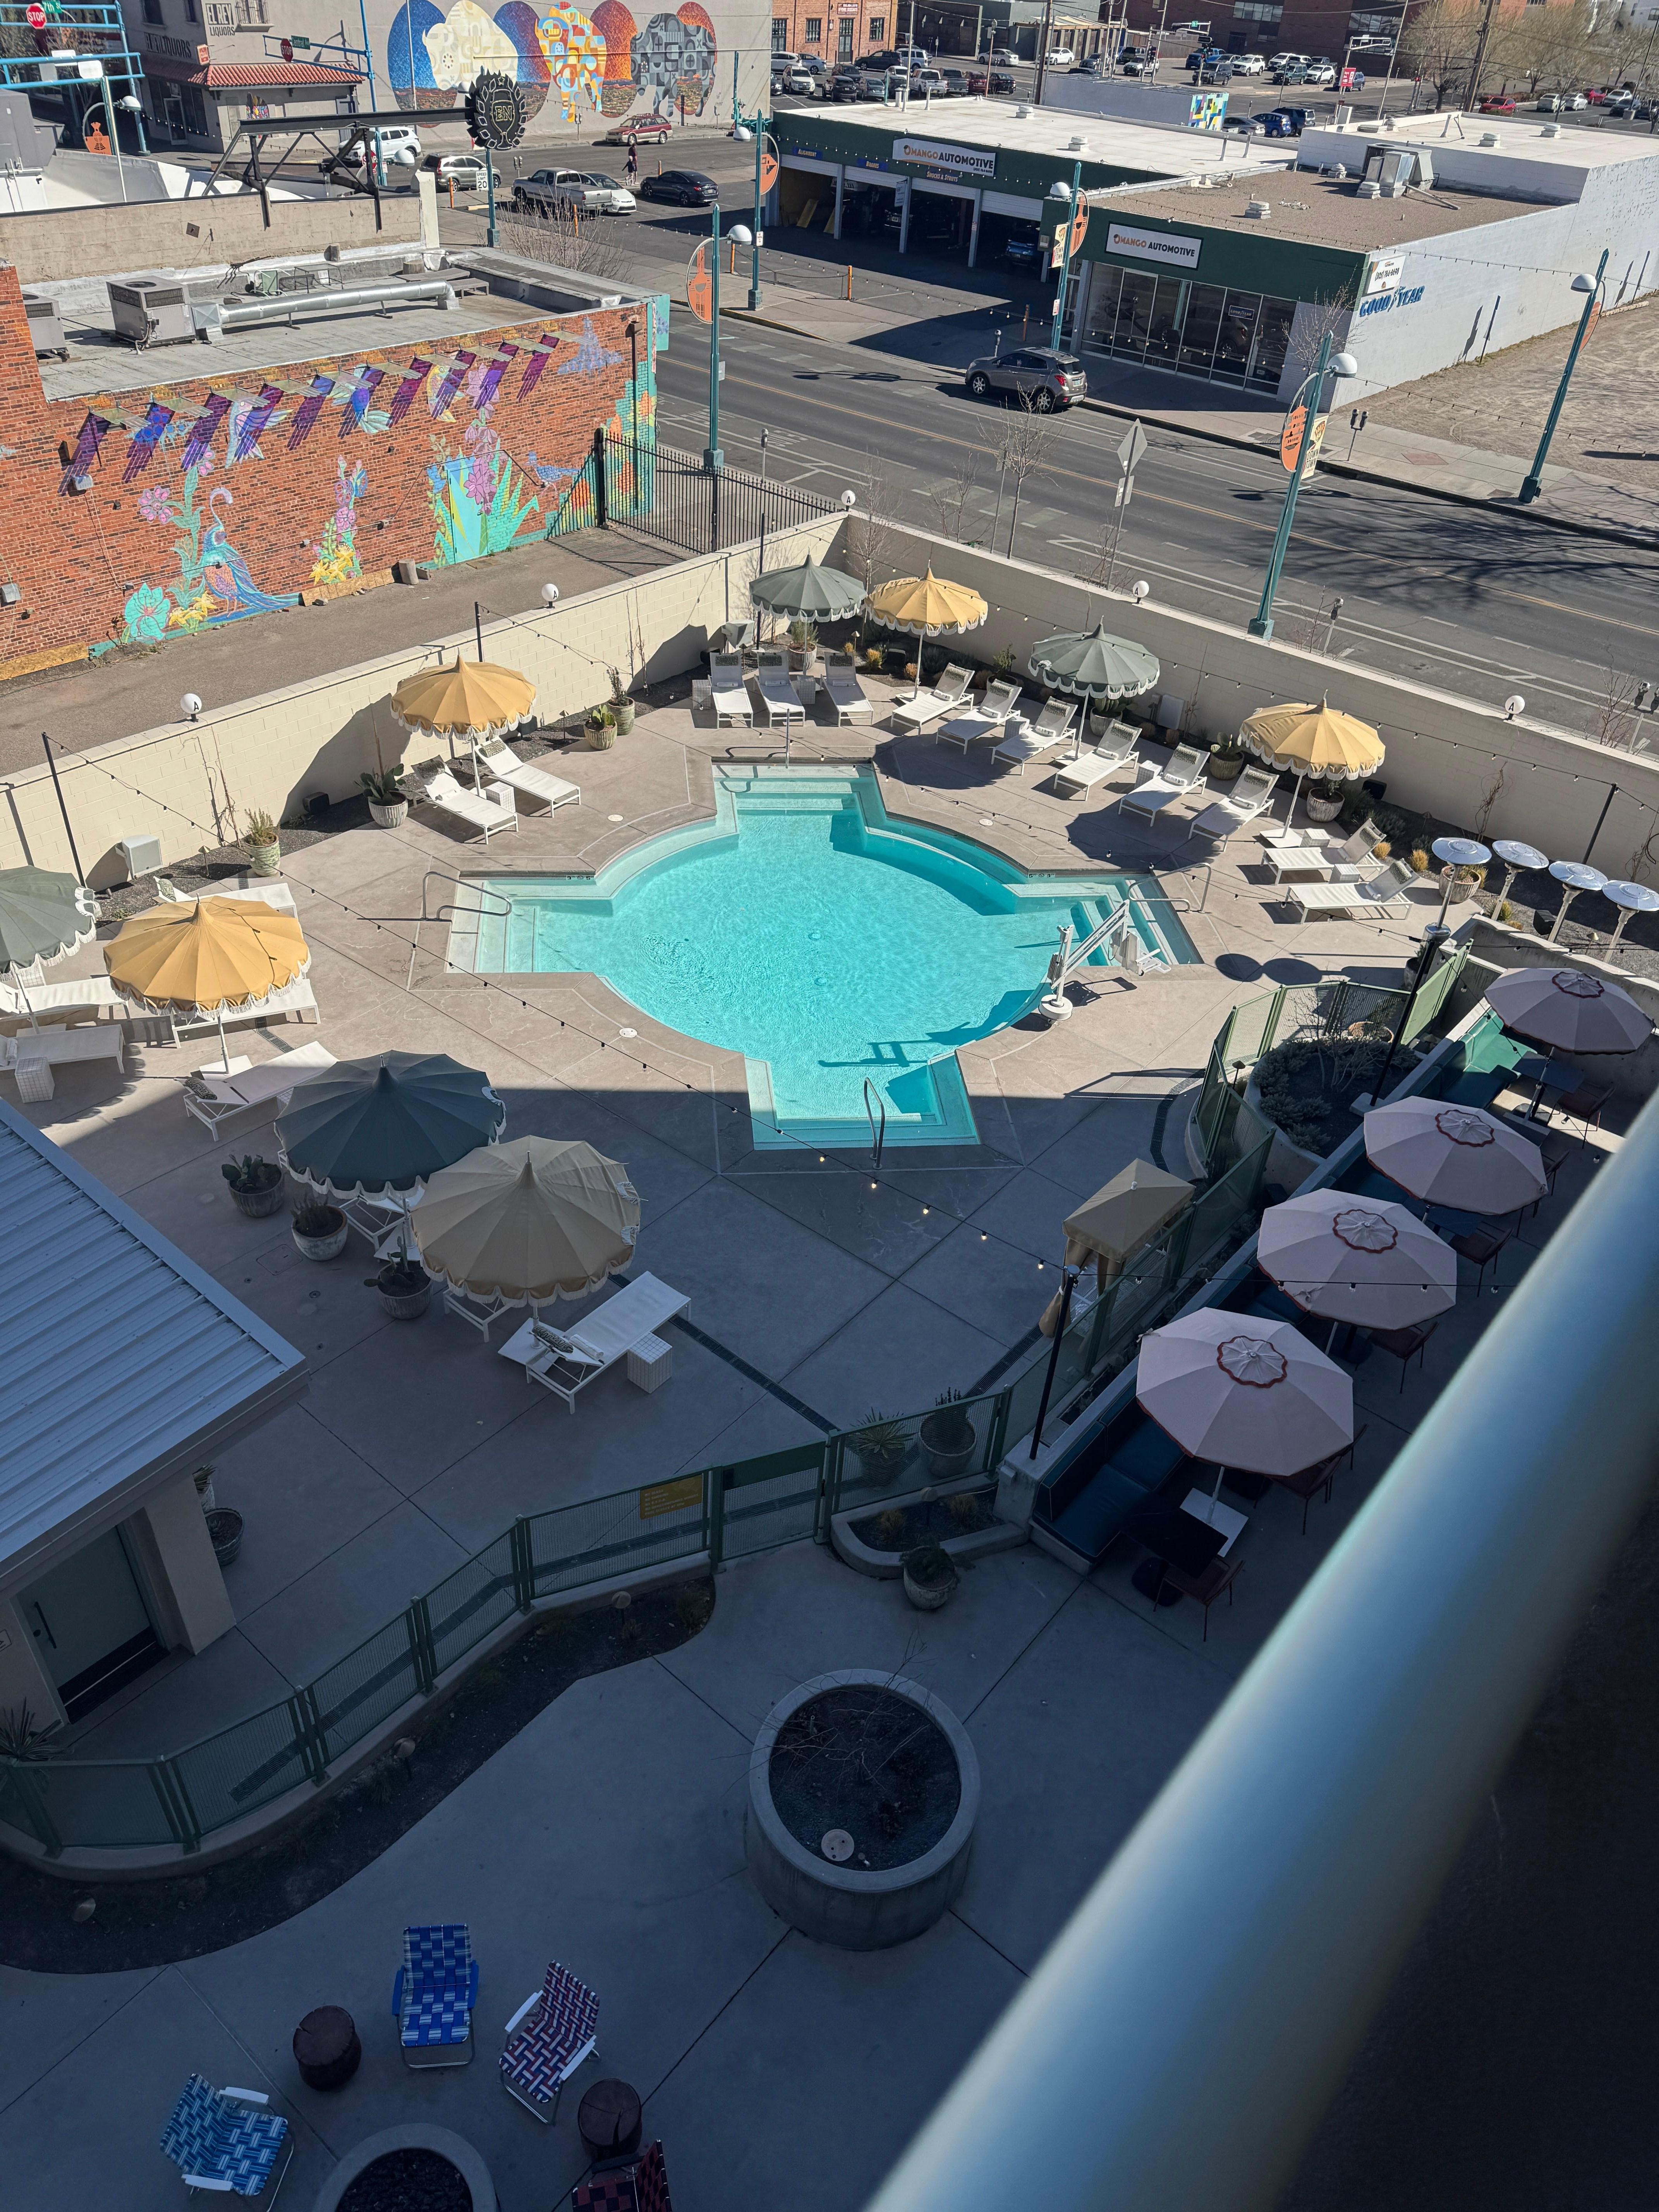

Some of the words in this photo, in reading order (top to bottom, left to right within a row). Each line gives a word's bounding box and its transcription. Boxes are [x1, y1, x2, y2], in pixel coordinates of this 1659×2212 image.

[28, 12, 44, 22] STOP
[206, 4, 217, 24] EL
[216, 4, 232, 24] REY
[209, 26, 235, 37] LIQUORS
[282, 46, 292, 55] STOP
[495, 106, 512, 121] EN
[938, 152, 994, 169] AUTOMOTIVE
[1148, 242, 1195, 257] AUTOMOTIVE
[1307, 449, 1319, 460] DOWN
[1305, 459, 1316, 469] TOWN
[553, 590, 557, 599] A
[1135, 587, 1139, 595] A
[194, 701, 199, 711] A
[1508, 702, 1514, 711] A
